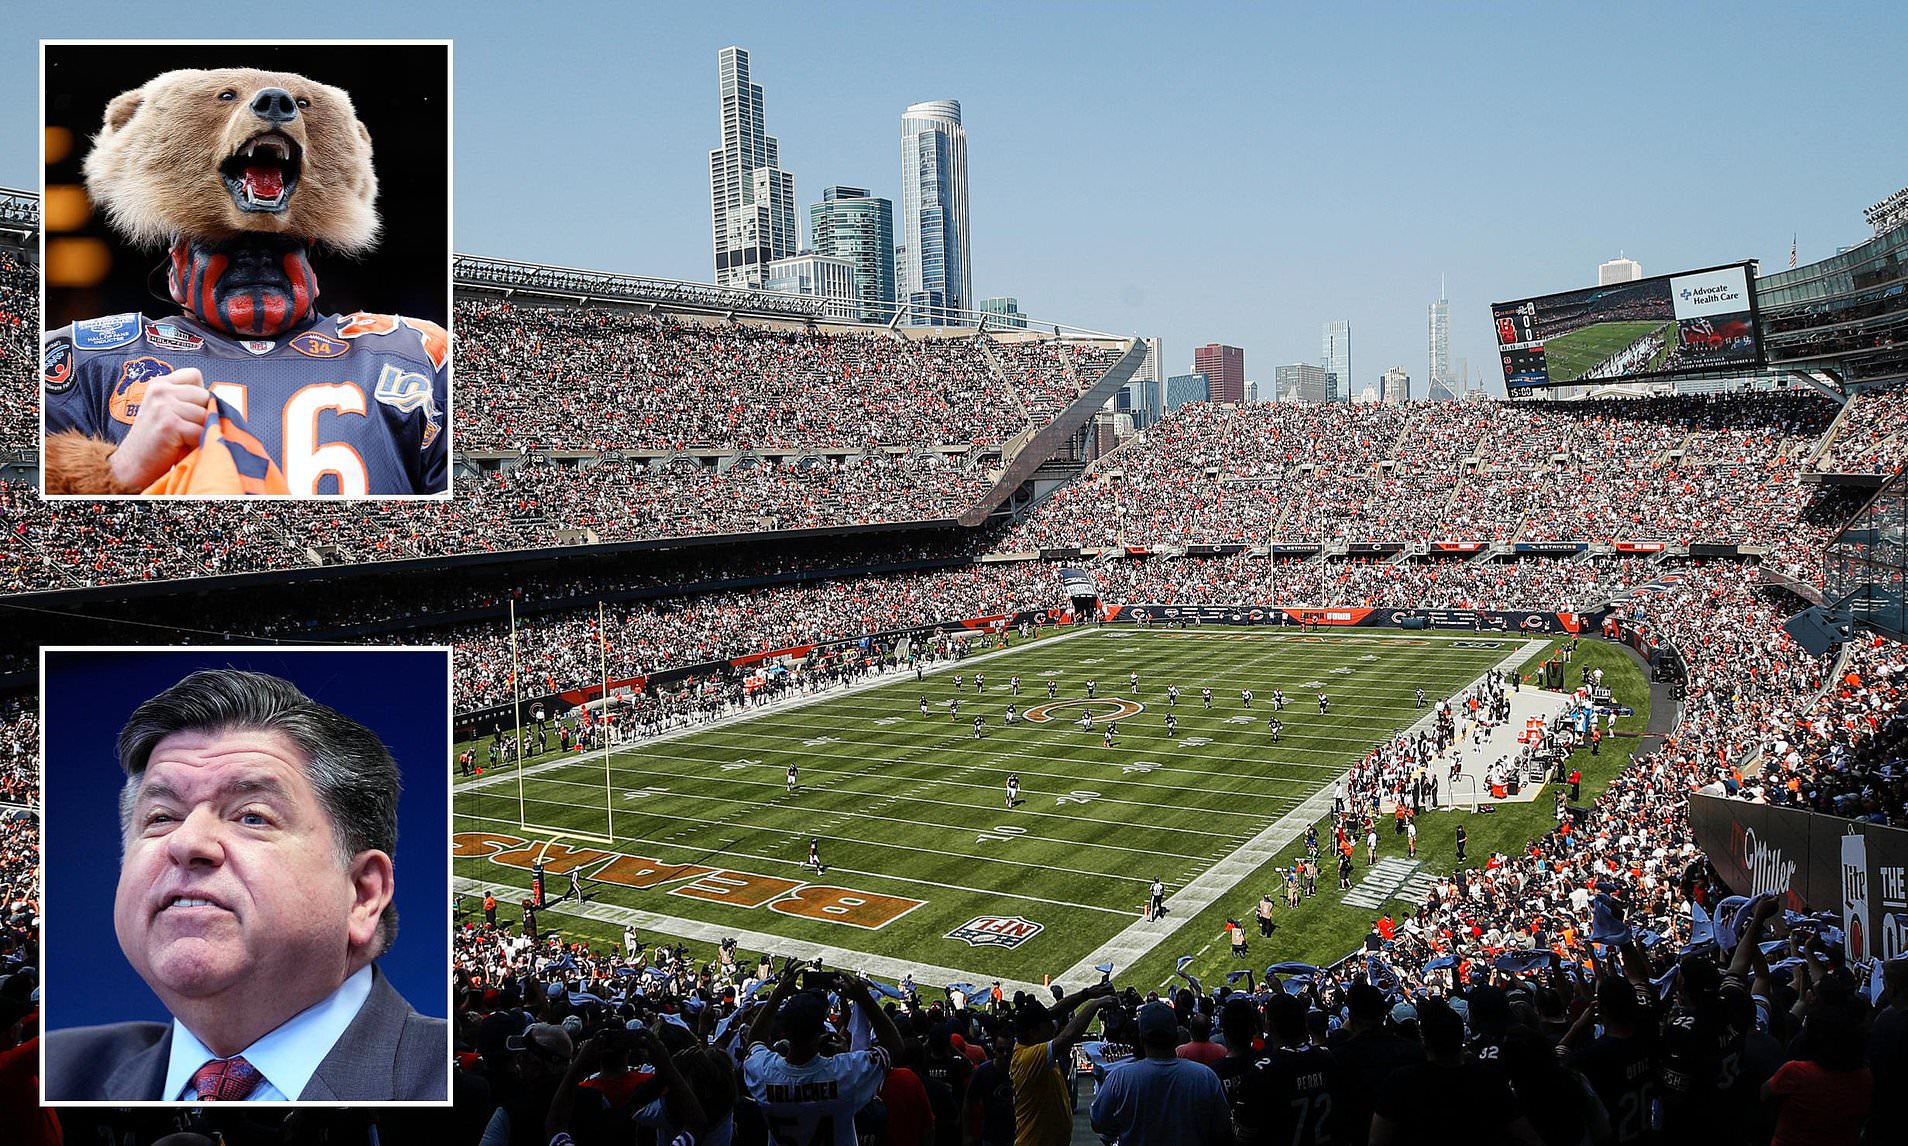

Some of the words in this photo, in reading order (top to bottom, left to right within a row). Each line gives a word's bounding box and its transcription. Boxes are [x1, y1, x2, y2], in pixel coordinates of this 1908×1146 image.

[1693, 284, 1728, 297] Advocate
[1694, 294, 1719, 305] Health
[1720, 292, 1739, 301] Care
[1523, 315, 1531, 328] 0
[1525, 329, 1533, 341] 0
[249, 341, 267, 351] NFL
[308, 339, 331, 354] 34
[530, 455, 544, 463] 15:00
[1056, 790, 1102, 806] 20
[975, 825, 1028, 844] 10
[1744, 826, 1797, 899] Miller
[1340, 855, 1422, 910] WELCOME
[1880, 867, 1906, 899] THE
[974, 919, 1036, 937] NFL
[1673, 1016, 1695, 1030] 52
[1296, 1071, 1325, 1090] PERRY
[1290, 1091, 1332, 1146] 72
